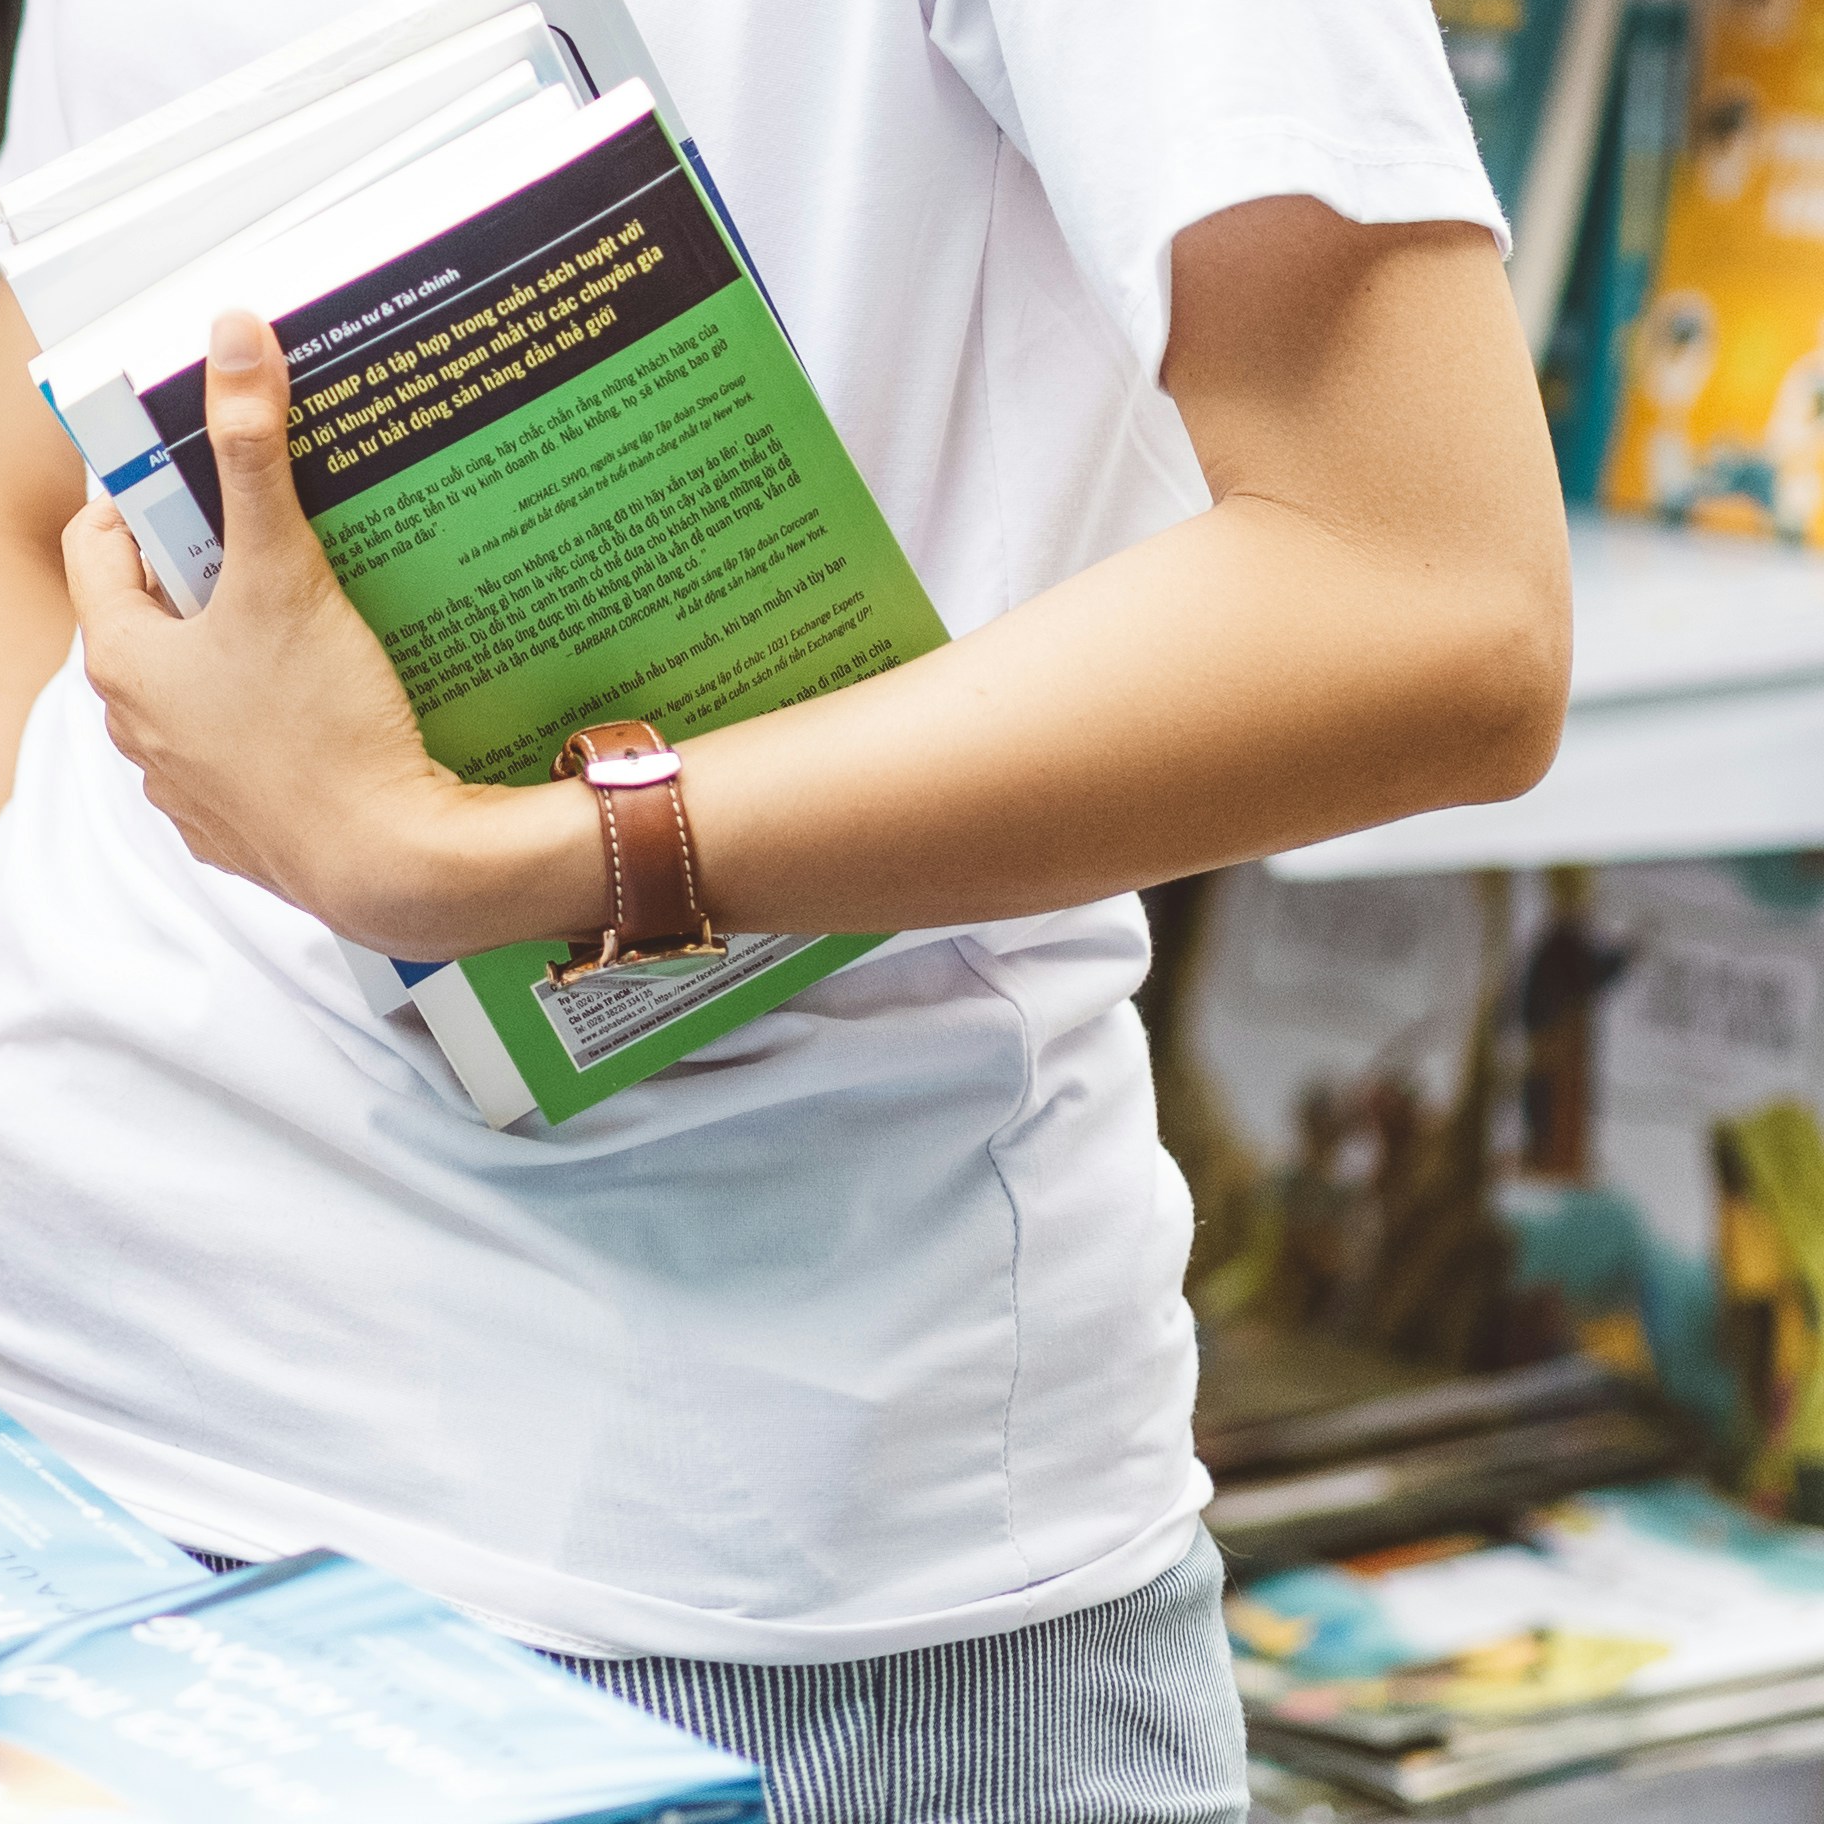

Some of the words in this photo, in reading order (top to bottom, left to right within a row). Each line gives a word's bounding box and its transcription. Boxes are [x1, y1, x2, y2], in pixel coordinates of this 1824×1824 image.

[302, 373, 362, 417] TRUMP
[365, 361, 390, 387] đã
[386, 349, 418, 374] tập
[415, 332, 452, 359] hợp
[449, 307, 499, 341] trong
[495, 284, 538, 316] cuốn
[536, 260, 578, 294] sách
[574, 235, 620, 271] tuyệt
[616, 217, 646, 247] vời
[310, 421, 338, 447] lời
[334, 394, 398, 435] khuyên
[394, 372, 440, 404] khôn
[438, 345, 491, 382] ngoan
[489, 321, 530, 354] nhất
[525, 310, 548, 333] từ
[547, 295, 580, 322] các
[578, 261, 638, 304] chuyên
[636, 245, 665, 274] gia
[326, 445, 360, 475] đầu
[357, 434, 380, 457] tư
[377, 418, 411, 447] bất
[409, 399, 454, 431] động
[450, 383, 483, 409] sản
[479, 359, 527, 392] hàng
[524, 340, 558, 370] đầu
[554, 319, 585, 351] thế
[585, 303, 618, 339] giới
[328, 319, 363, 344] Đầu
[360, 307, 382, 327] tư
[379, 301, 396, 318] &
[391, 287, 419, 310] Tài
[417, 267, 462, 298] chính
